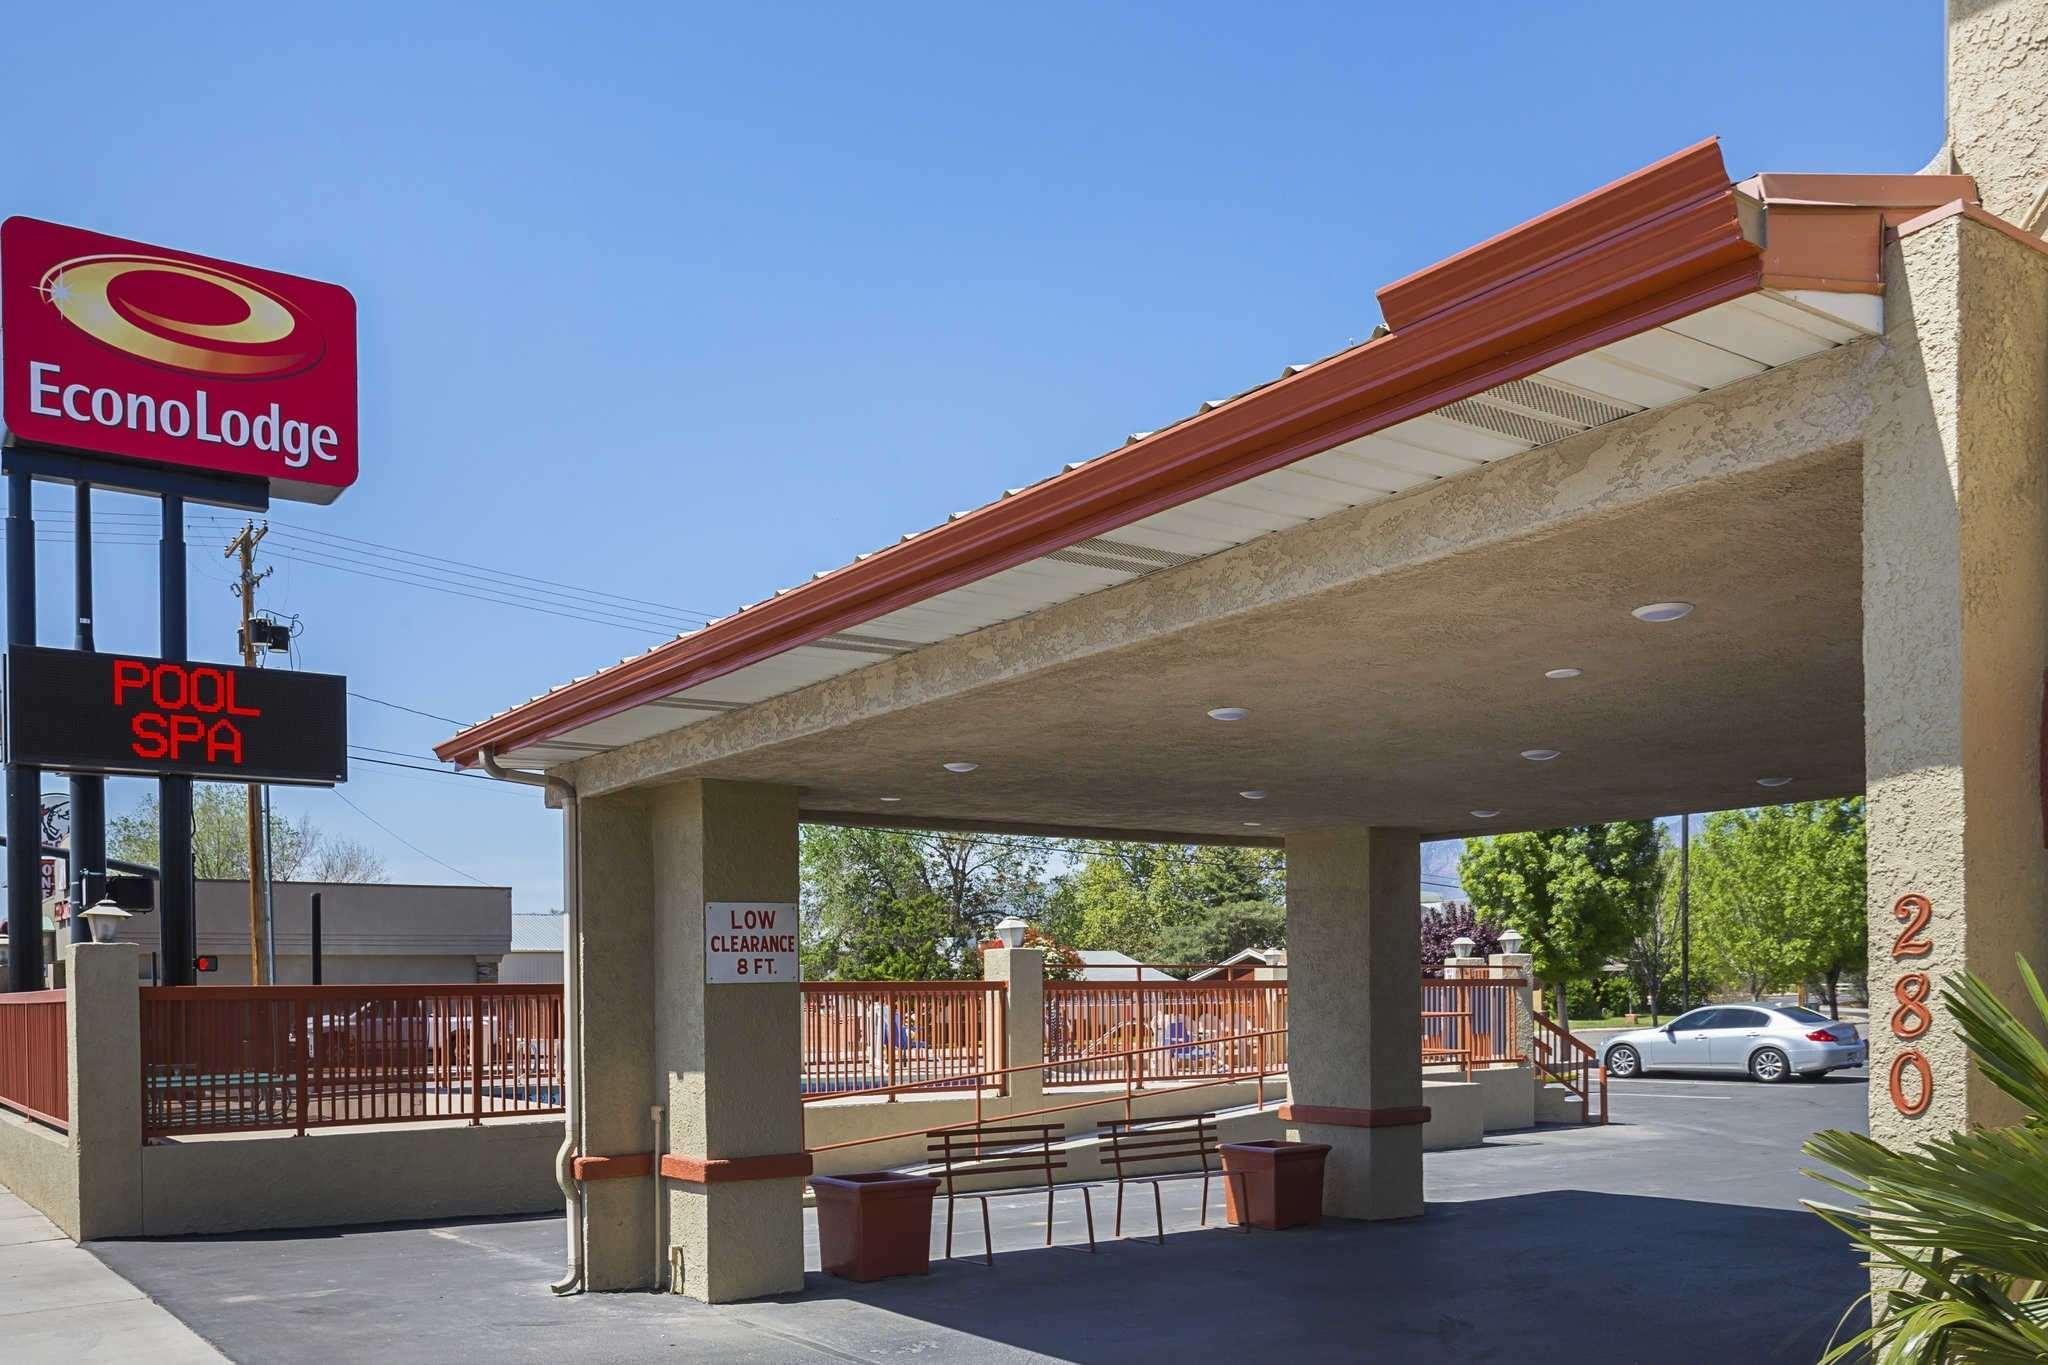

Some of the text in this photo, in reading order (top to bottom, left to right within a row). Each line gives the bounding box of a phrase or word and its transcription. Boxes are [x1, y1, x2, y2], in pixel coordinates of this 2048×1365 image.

[112, 659, 261, 717] POOL
[131, 712, 243, 763] SPA
[730, 910, 776, 930] LOW
[710, 935, 795, 953] CLEARANCE
[736, 958, 777, 975] 8 FT.
[1889, 893, 1934, 1116] 280
